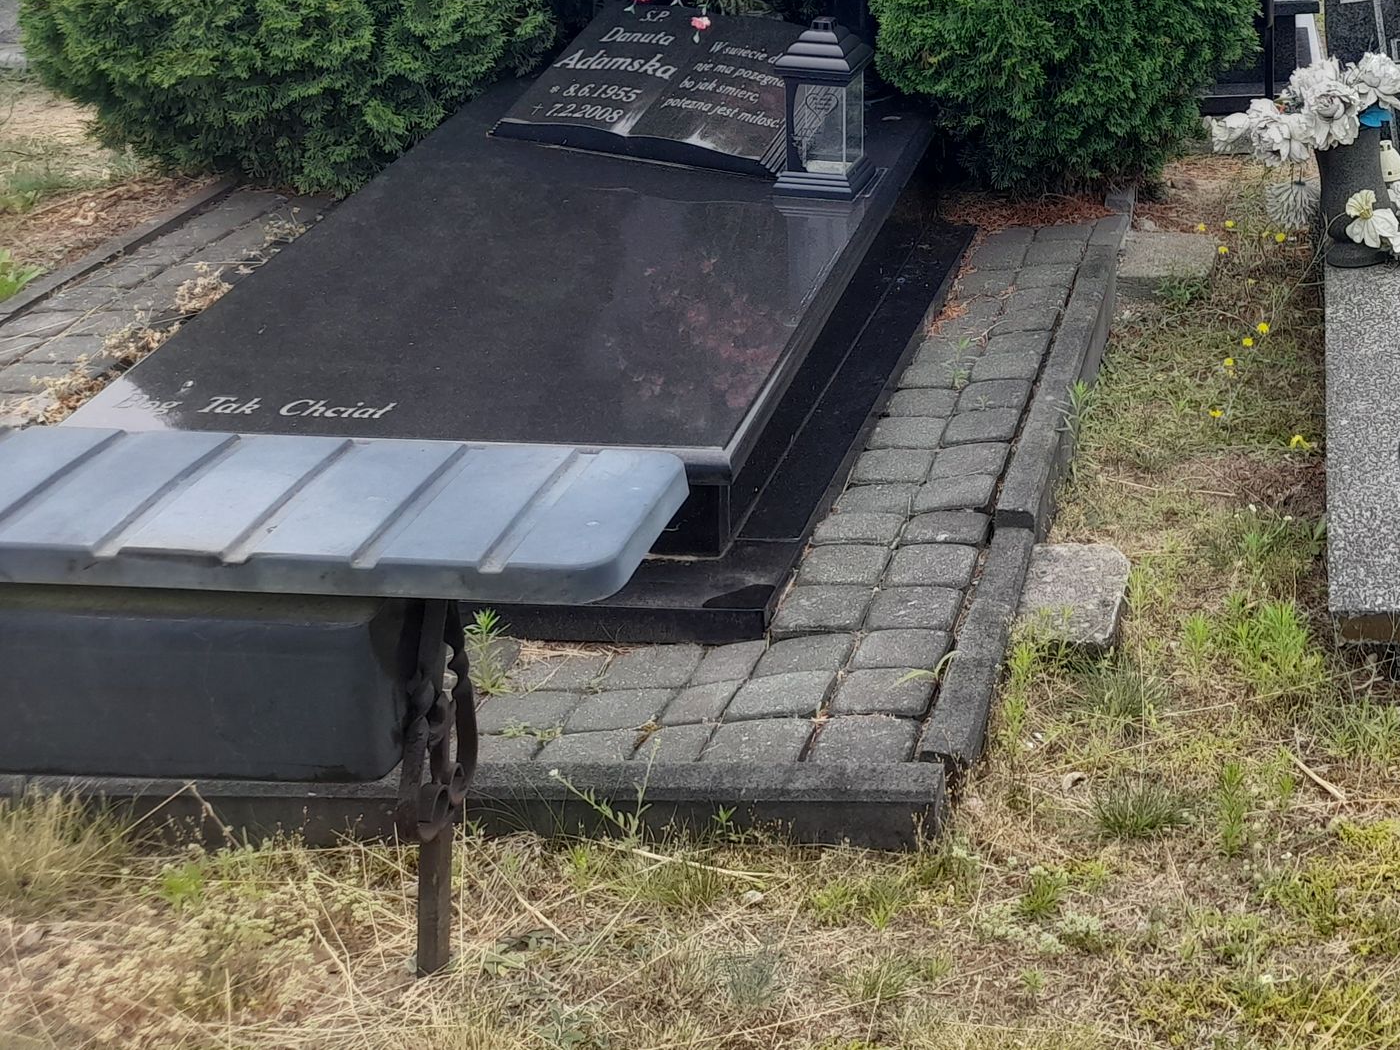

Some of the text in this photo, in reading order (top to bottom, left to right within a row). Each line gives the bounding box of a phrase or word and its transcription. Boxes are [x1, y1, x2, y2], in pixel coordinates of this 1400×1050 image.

[599, 26, 676, 47] Danuta
[708, 41, 729, 55] W
[553, 48, 678, 81] Adamska
[712, 64, 736, 75] ma
[562, 83, 643, 103] 8.6.1955
[679, 75, 696, 89] bo
[690, 77, 719, 92] jak
[544, 102, 625, 124] 7.2.2008
[706, 101, 740, 119] jest
[197, 396, 263, 415] Tak
